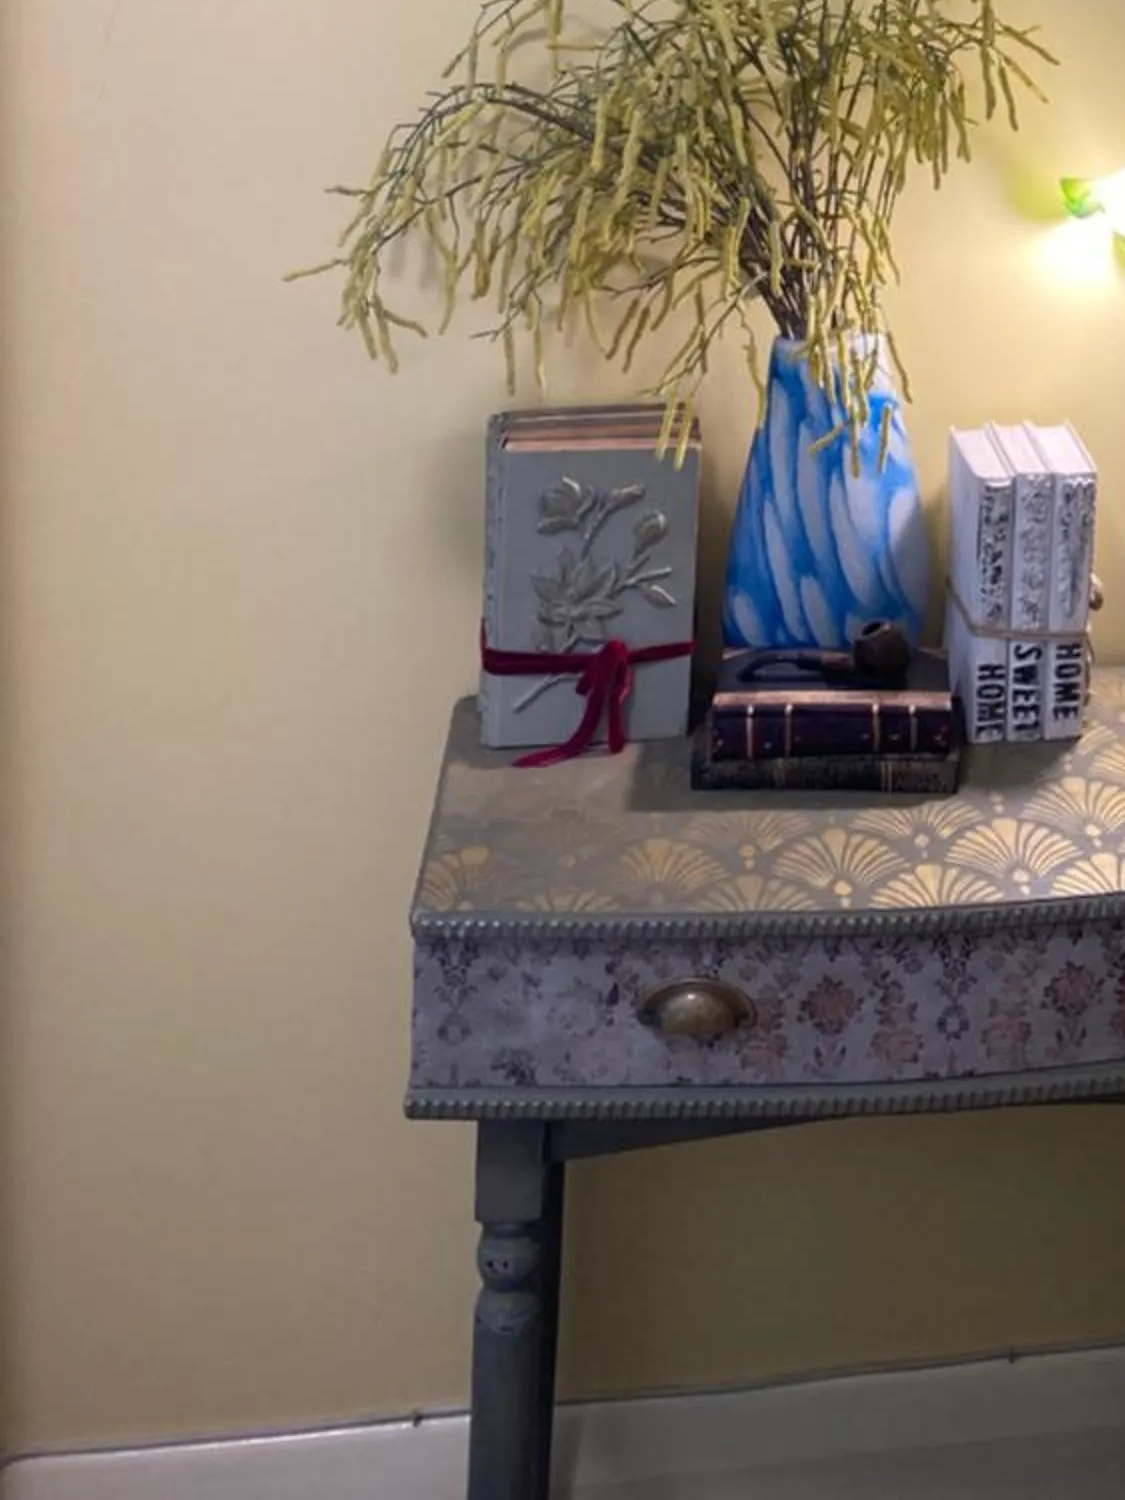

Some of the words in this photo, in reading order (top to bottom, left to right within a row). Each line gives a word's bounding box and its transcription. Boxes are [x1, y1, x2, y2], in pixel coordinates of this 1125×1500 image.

[976, 664, 1006, 740] HOME
[1013, 644, 1042, 731] SWEET
[1053, 644, 1081, 720] HOME
